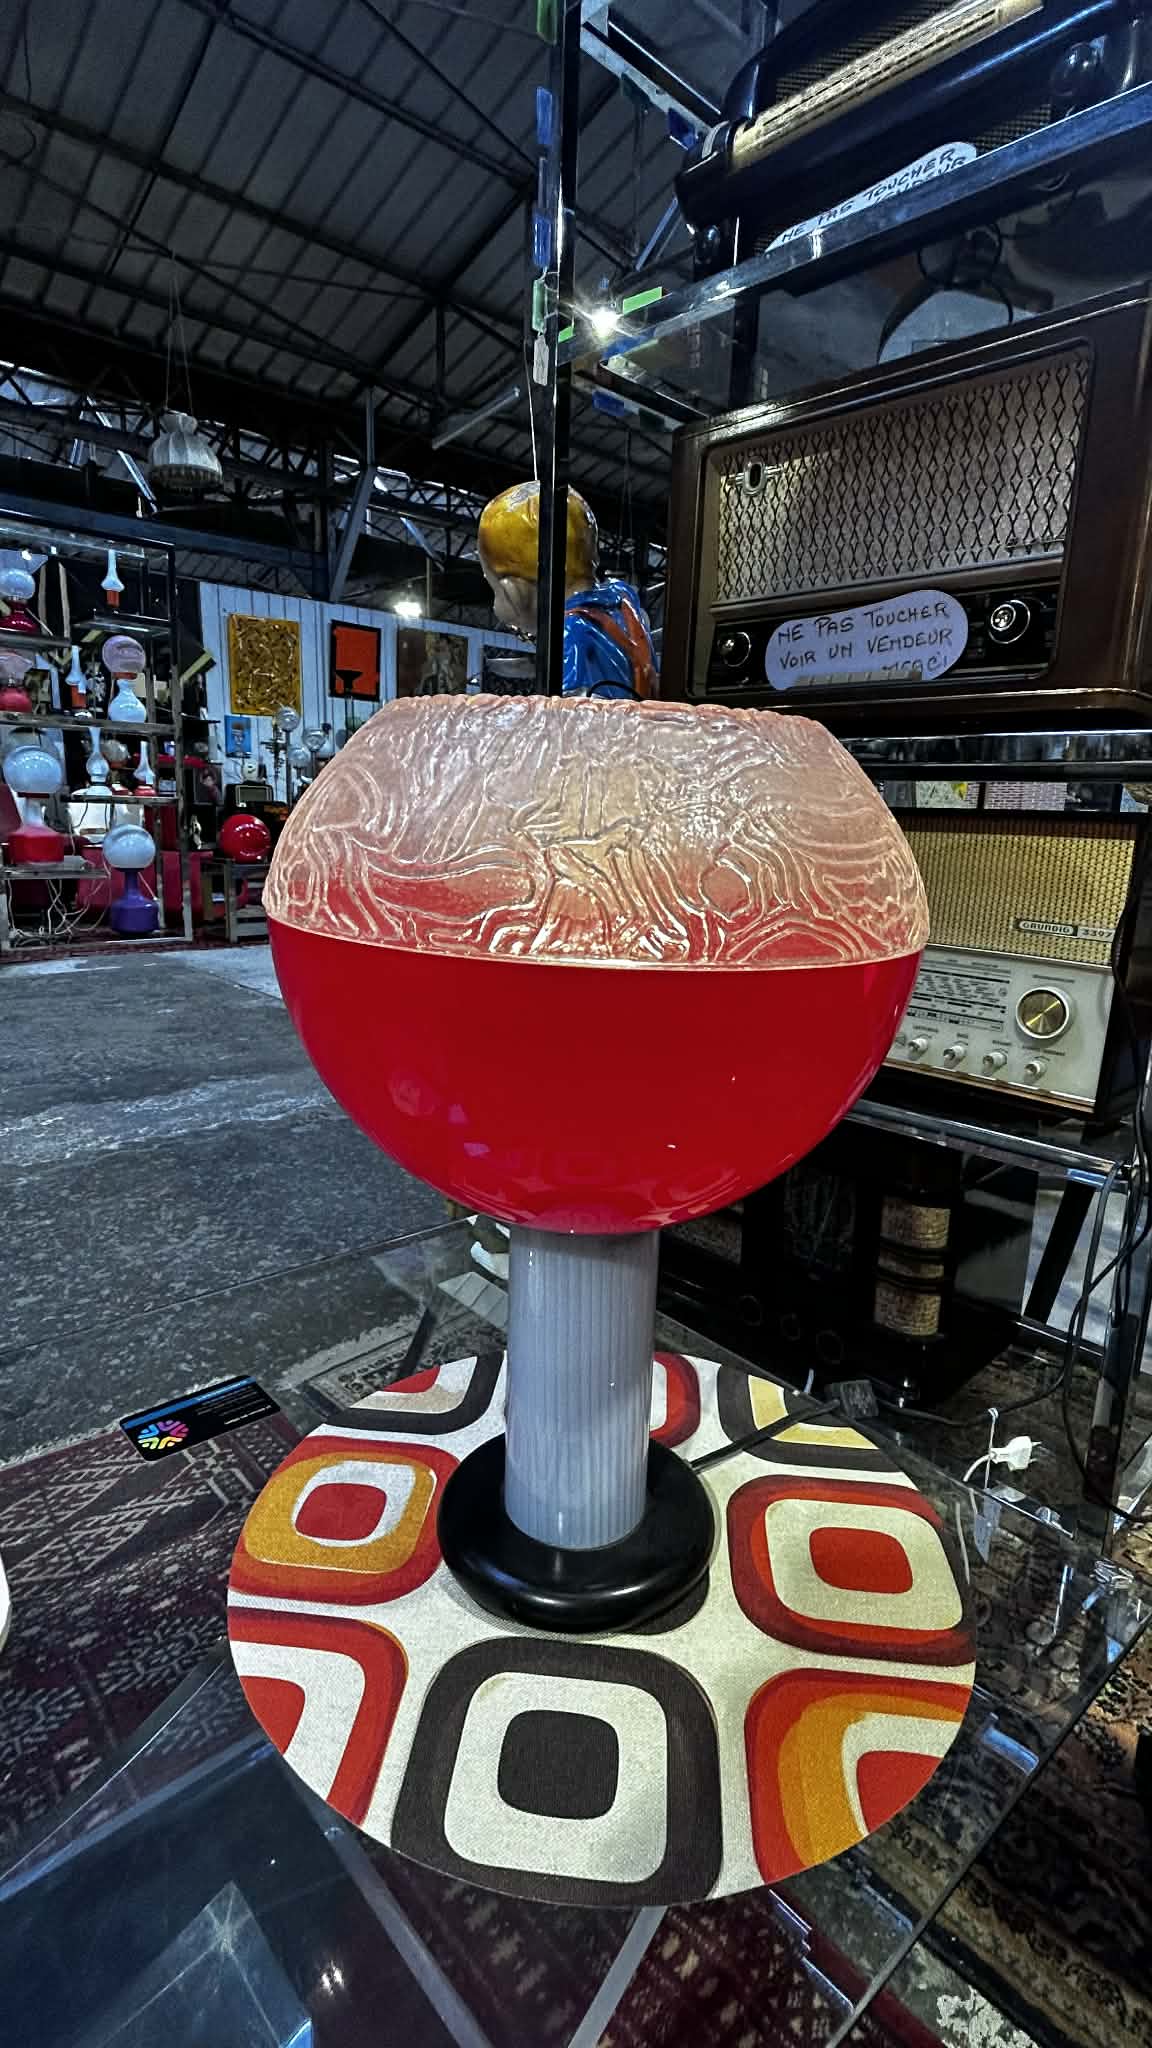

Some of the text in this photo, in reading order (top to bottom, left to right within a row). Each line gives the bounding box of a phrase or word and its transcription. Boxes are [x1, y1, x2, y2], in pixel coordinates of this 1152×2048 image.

[863, 148, 955, 201] TOUCHER
[778, 602, 950, 646] NE PAS TOUCHER
[780, 628, 953, 670] VOIR UN VENDEUR
[1022, 922, 1070, 934] GRUNDIG
